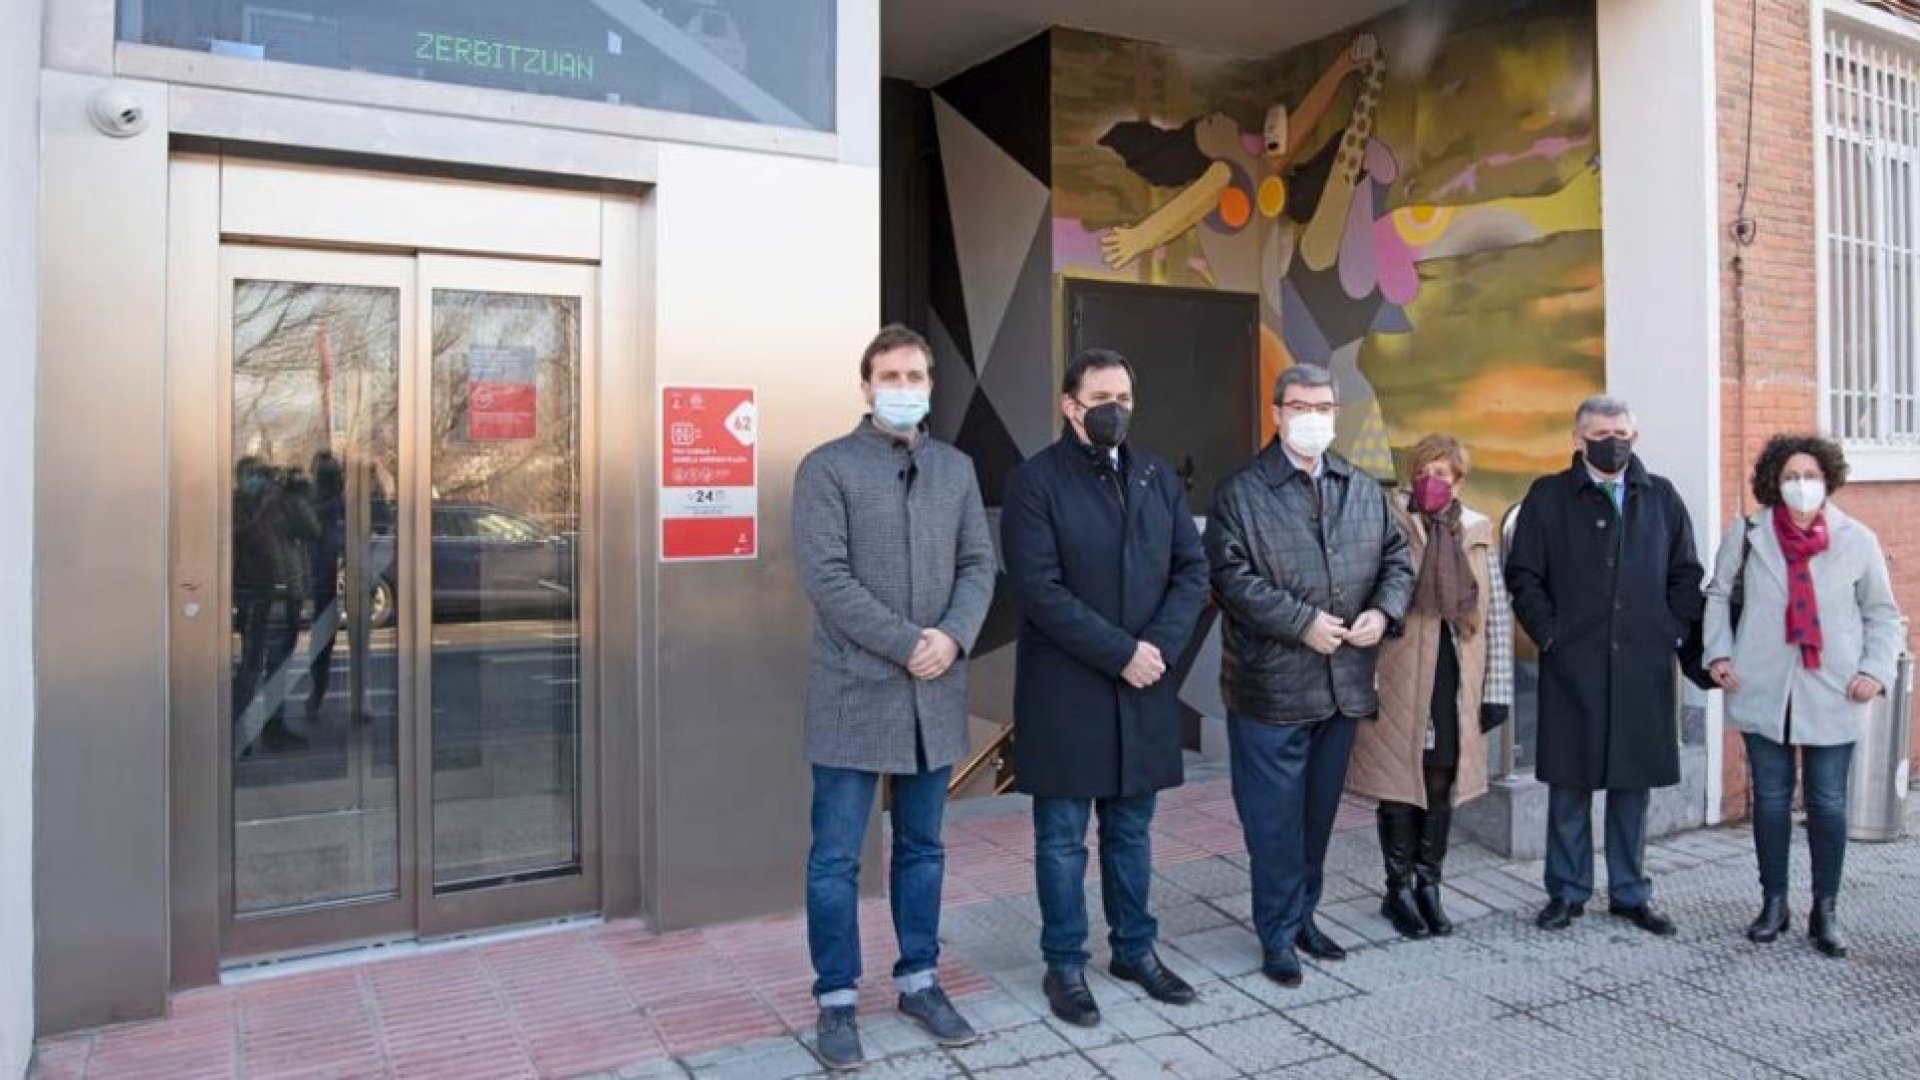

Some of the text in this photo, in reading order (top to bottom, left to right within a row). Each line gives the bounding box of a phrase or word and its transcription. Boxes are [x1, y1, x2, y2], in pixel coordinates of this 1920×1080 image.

[415, 31, 594, 81] ZERBITZUAN
[734, 415, 752, 431] 62
[695, 489, 713, 502] 24
